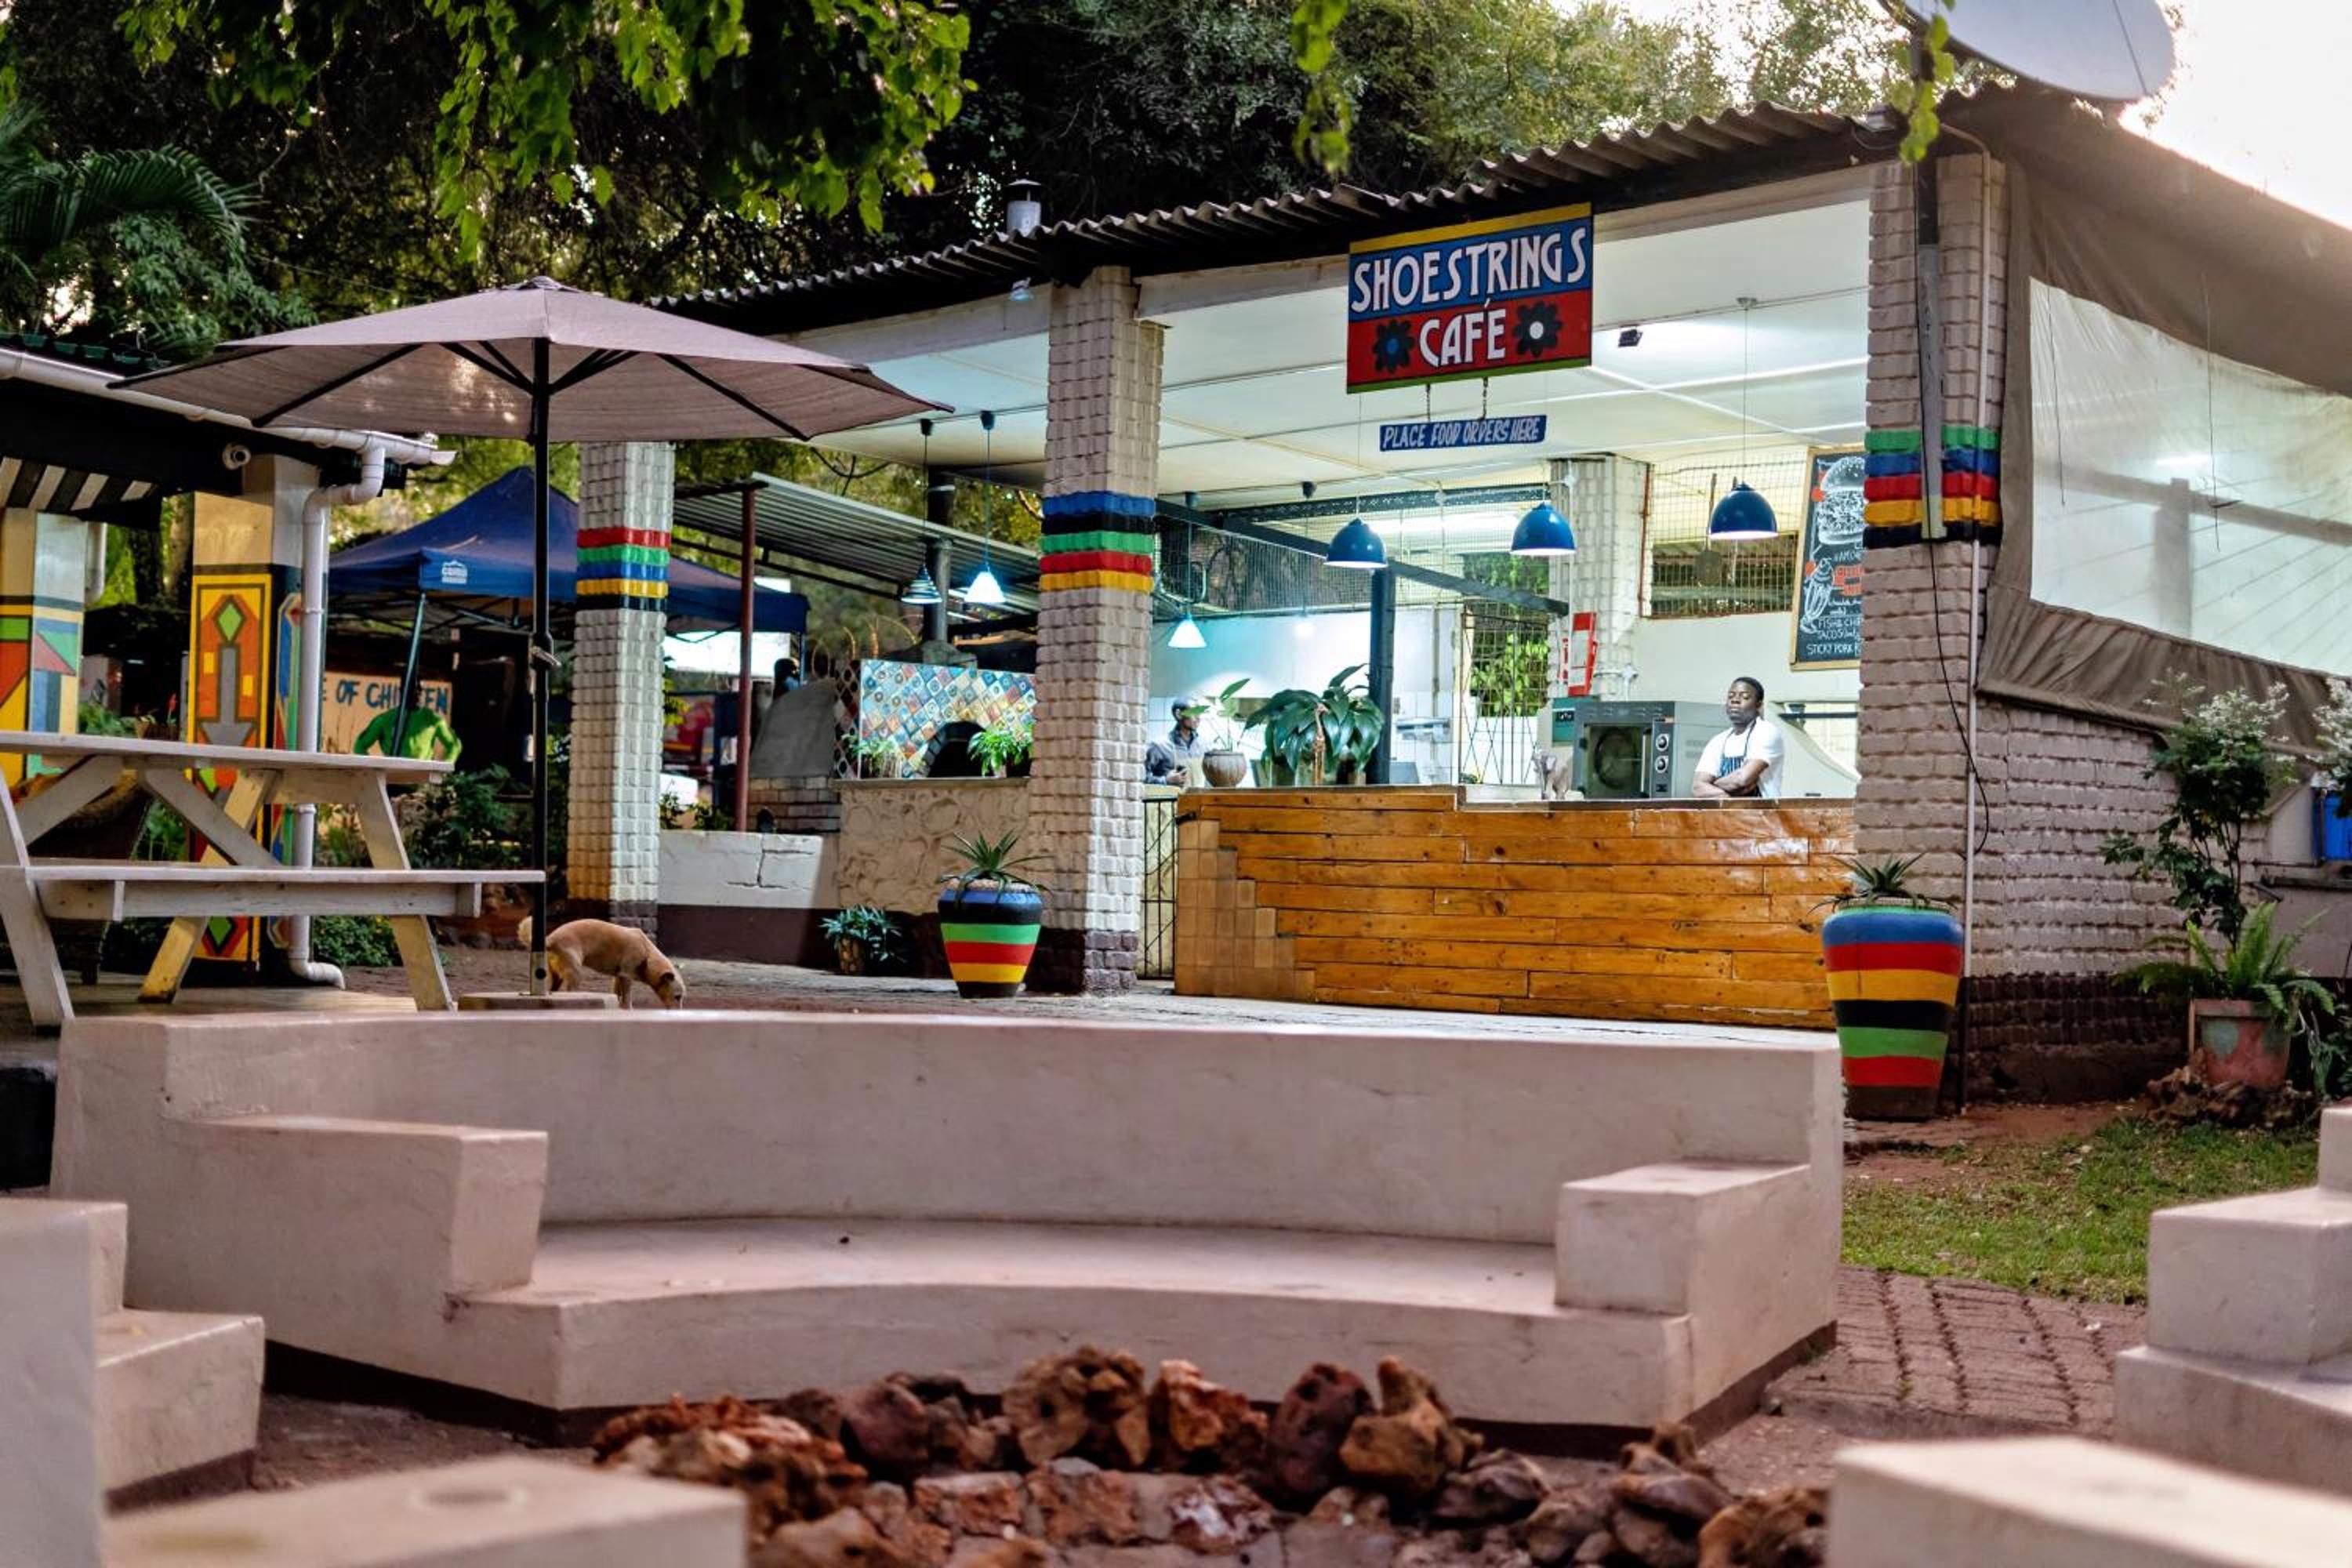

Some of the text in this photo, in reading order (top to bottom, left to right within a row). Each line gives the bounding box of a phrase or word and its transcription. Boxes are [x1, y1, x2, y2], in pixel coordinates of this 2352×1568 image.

[1351, 227, 1586, 313] SHOESTRINGS
[1419, 297, 1506, 367] CAFÉ
[1382, 417, 1541, 449] PLACE FOOD ORDERS HERE
[336, 679, 361, 705] OF
